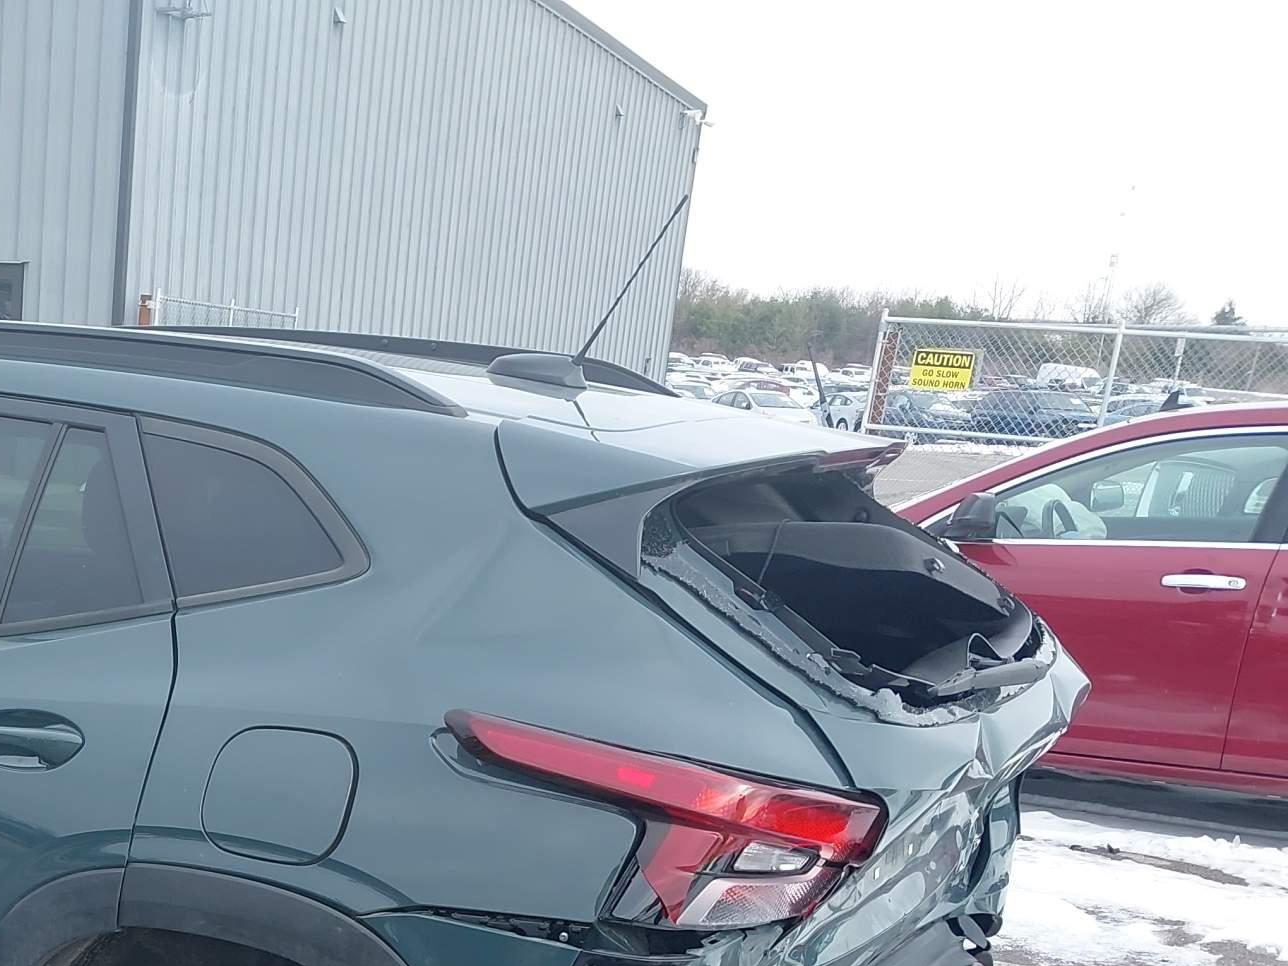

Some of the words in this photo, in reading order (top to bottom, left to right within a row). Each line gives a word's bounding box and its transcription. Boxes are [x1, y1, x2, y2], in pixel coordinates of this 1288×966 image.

[917, 352, 971, 368] CAUTION
[922, 369, 934, 377] GO
[936, 369, 960, 379] SLOW
[912, 377, 941, 388] SOUND
[942, 380, 966, 390] HORN
